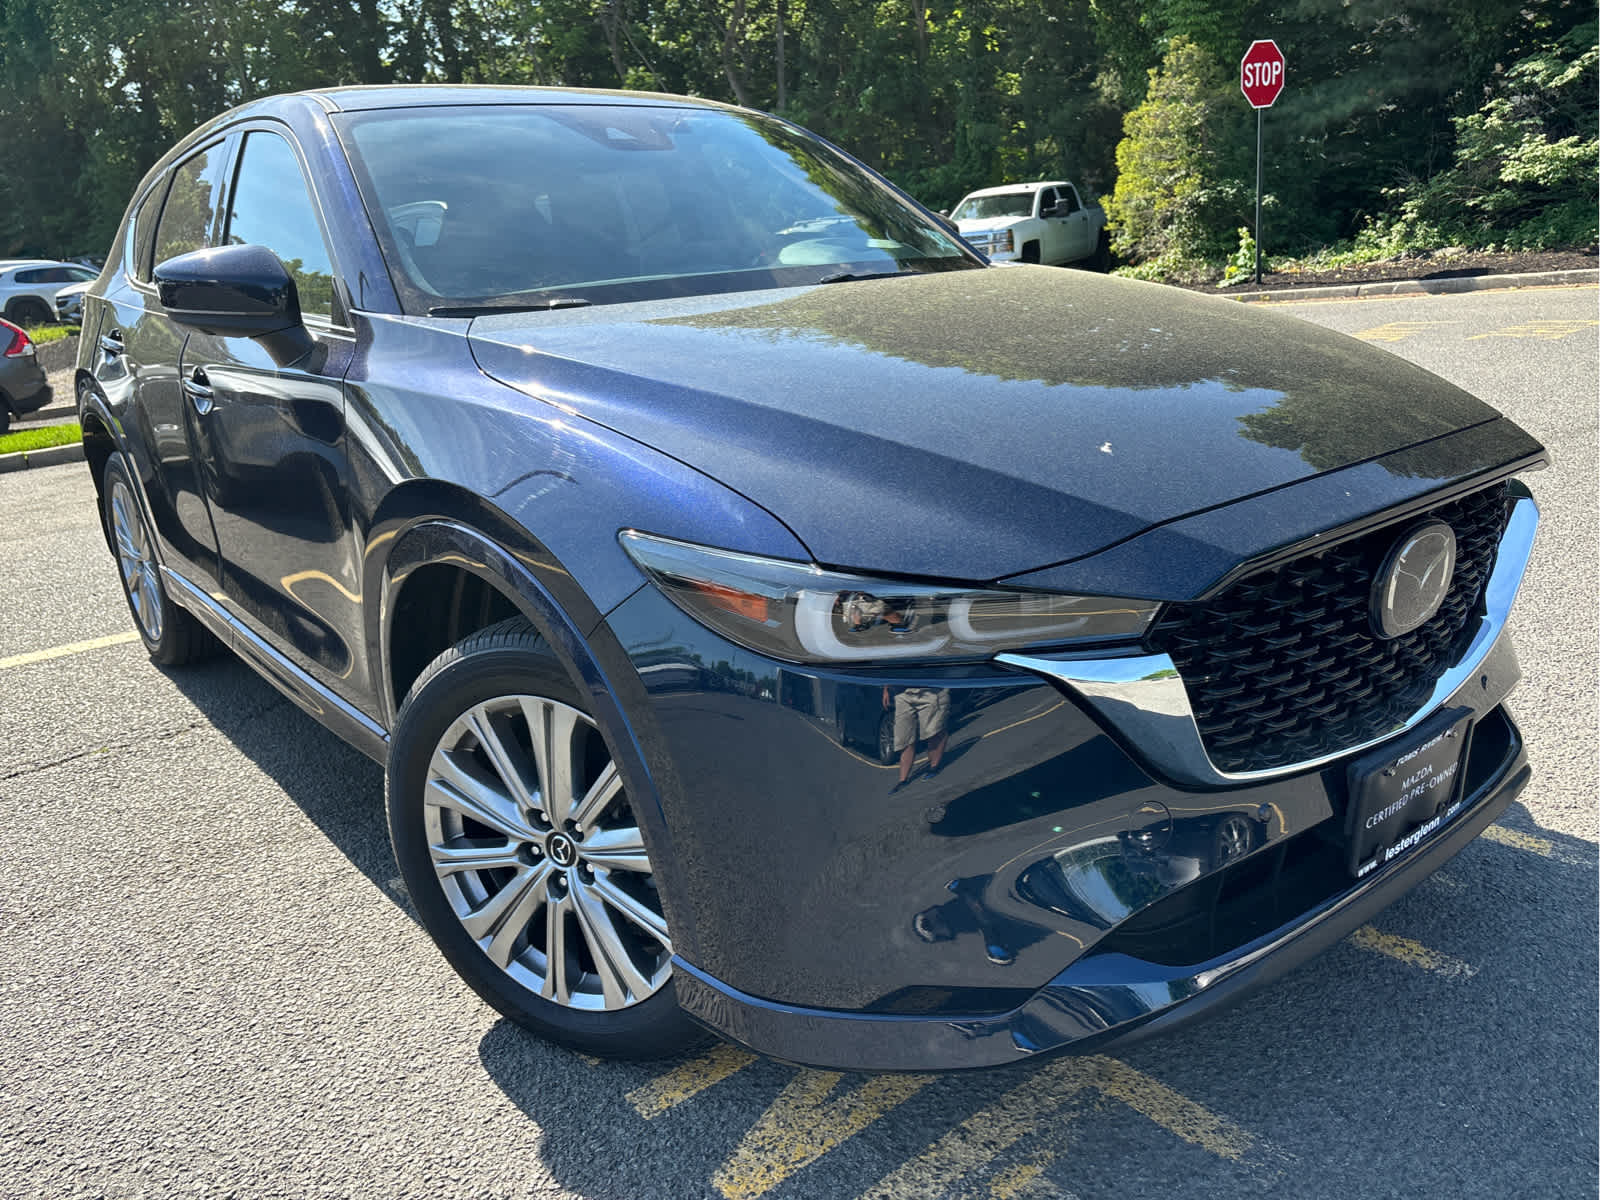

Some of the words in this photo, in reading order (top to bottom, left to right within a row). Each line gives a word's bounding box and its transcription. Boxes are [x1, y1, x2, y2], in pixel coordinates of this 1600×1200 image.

[1244, 61, 1281, 88] STOP
[1366, 794, 1408, 829] CERTIFIED
[1410, 762, 1458, 801] PRE-OWNED
[1401, 764, 1433, 791] MAZDA
[1385, 816, 1440, 861] lesterglenn
